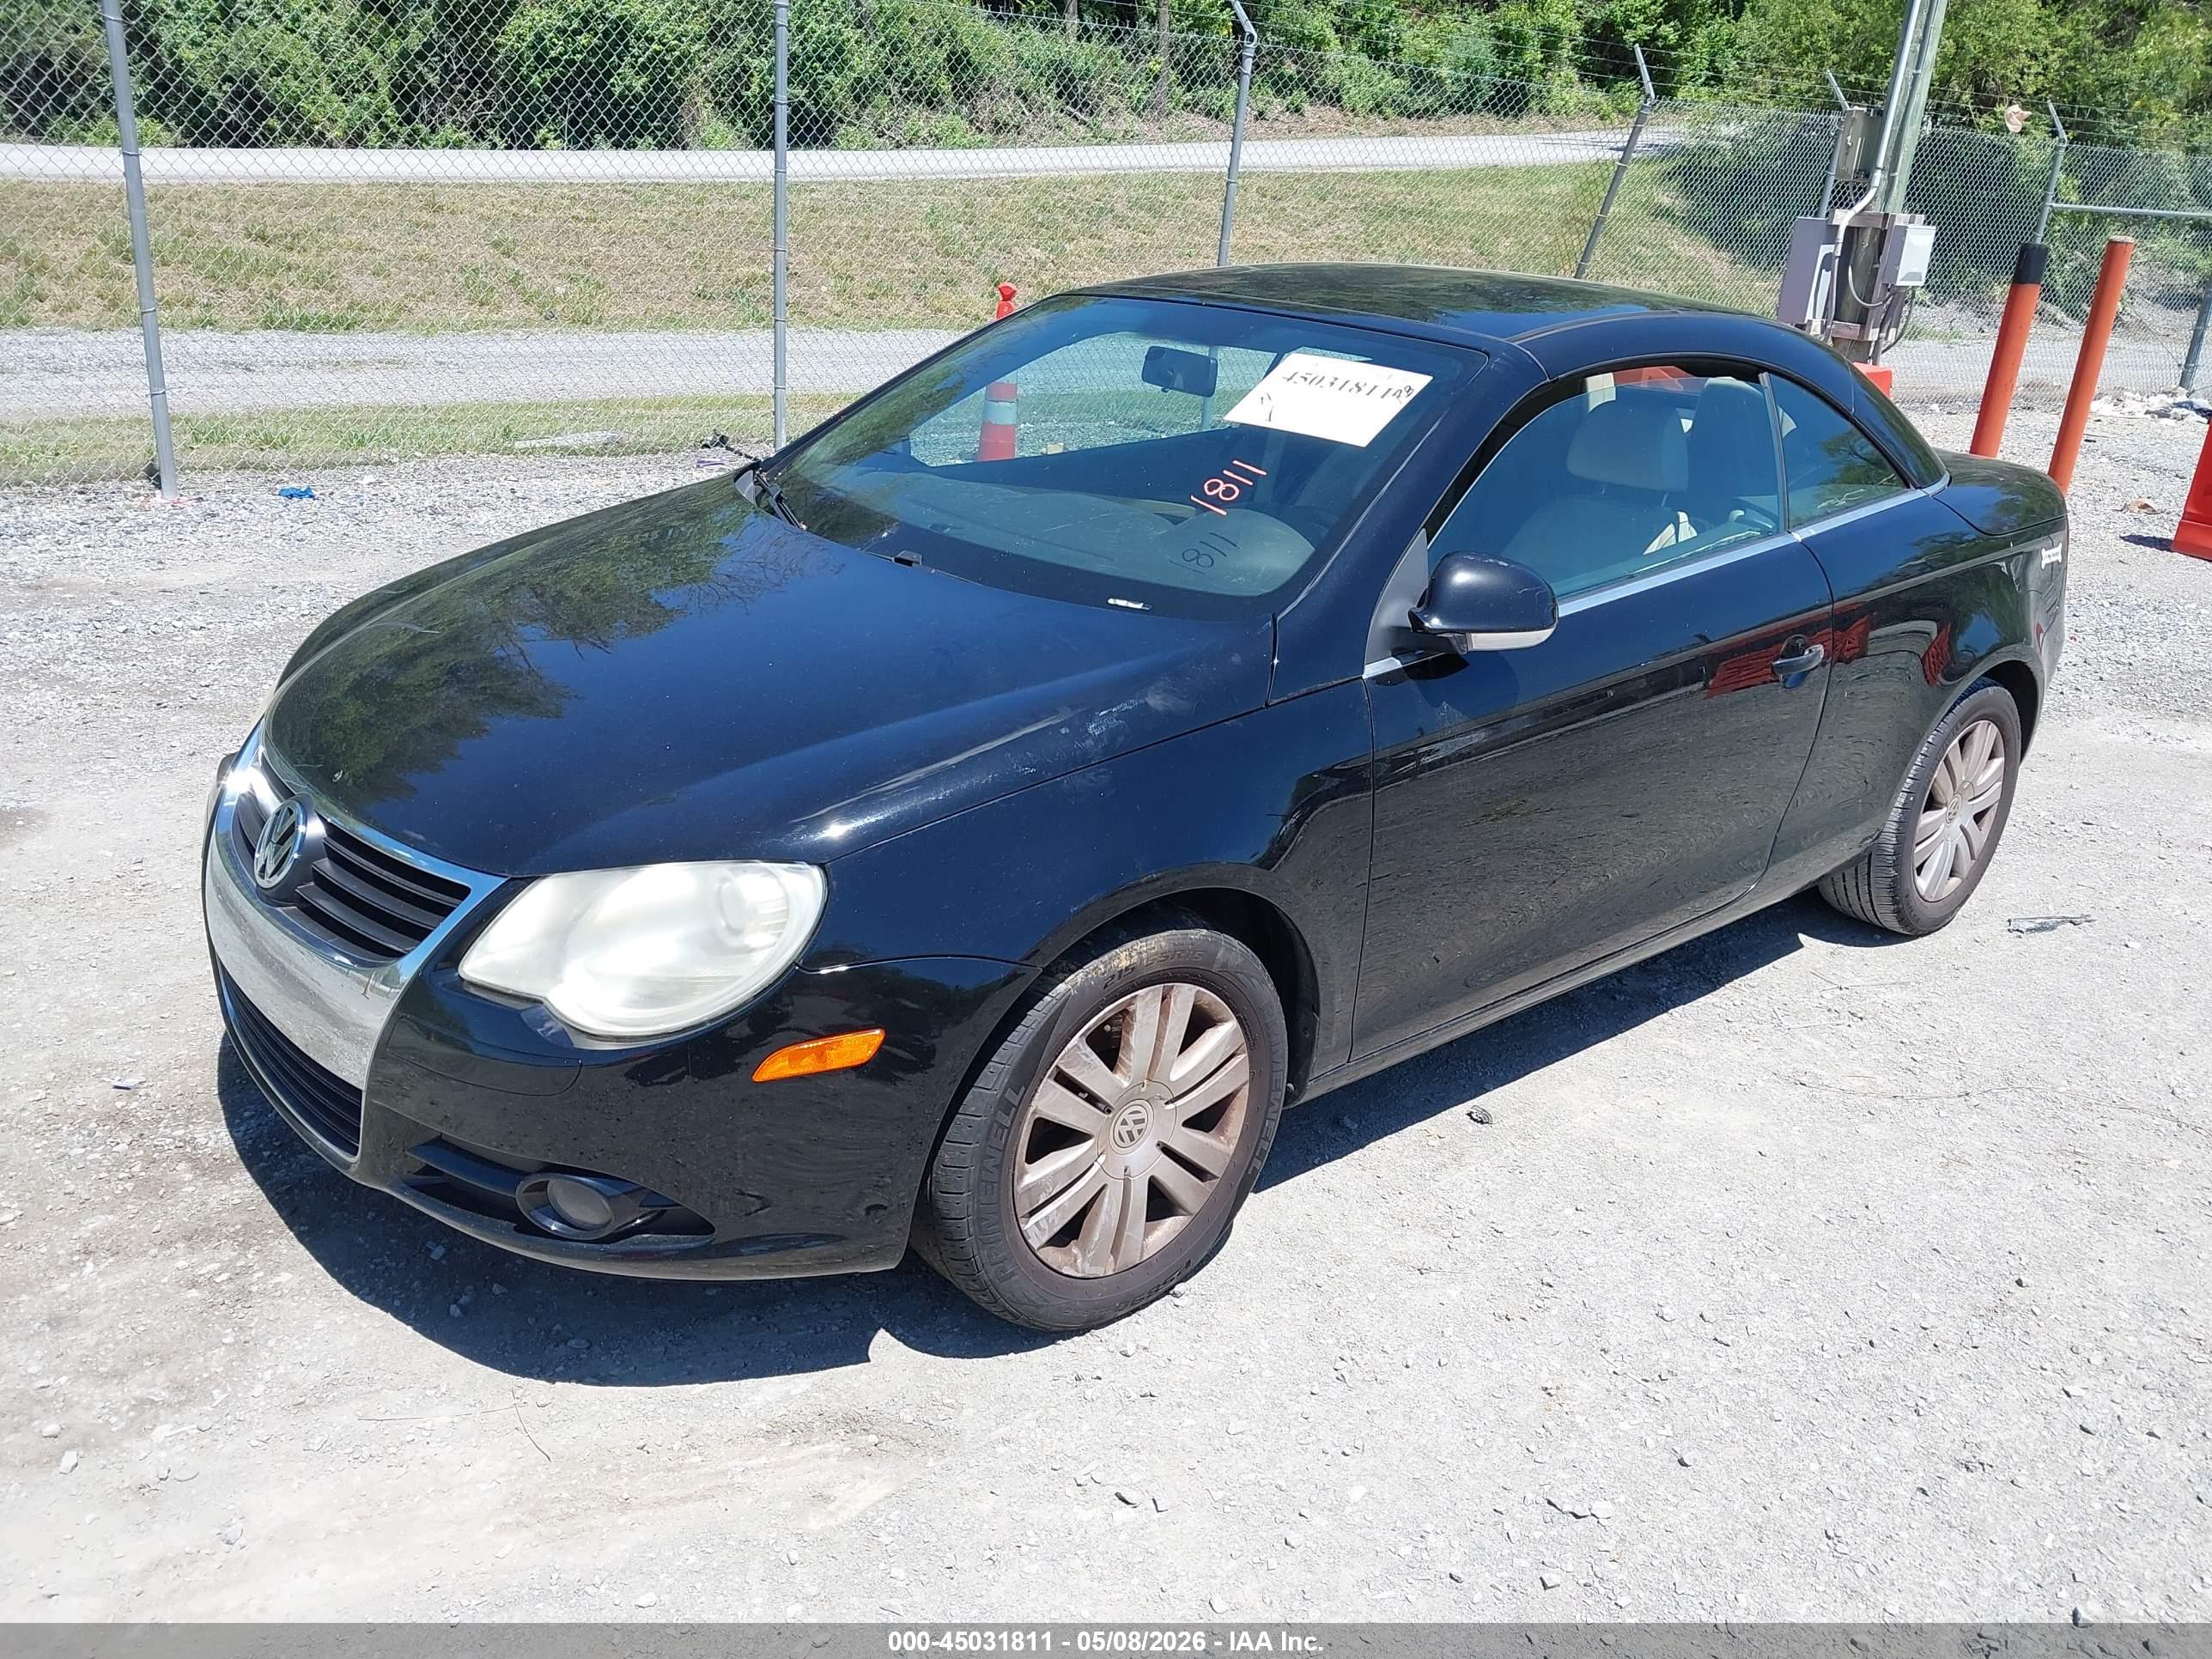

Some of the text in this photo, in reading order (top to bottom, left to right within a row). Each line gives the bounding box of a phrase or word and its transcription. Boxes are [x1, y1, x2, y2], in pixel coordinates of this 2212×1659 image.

[1282, 370, 1392, 399] 45031811
[1190, 459, 1267, 515] 1811
[1170, 532, 1241, 575] 1811
[979, 1085, 1026, 1285] PRIMEWELL
